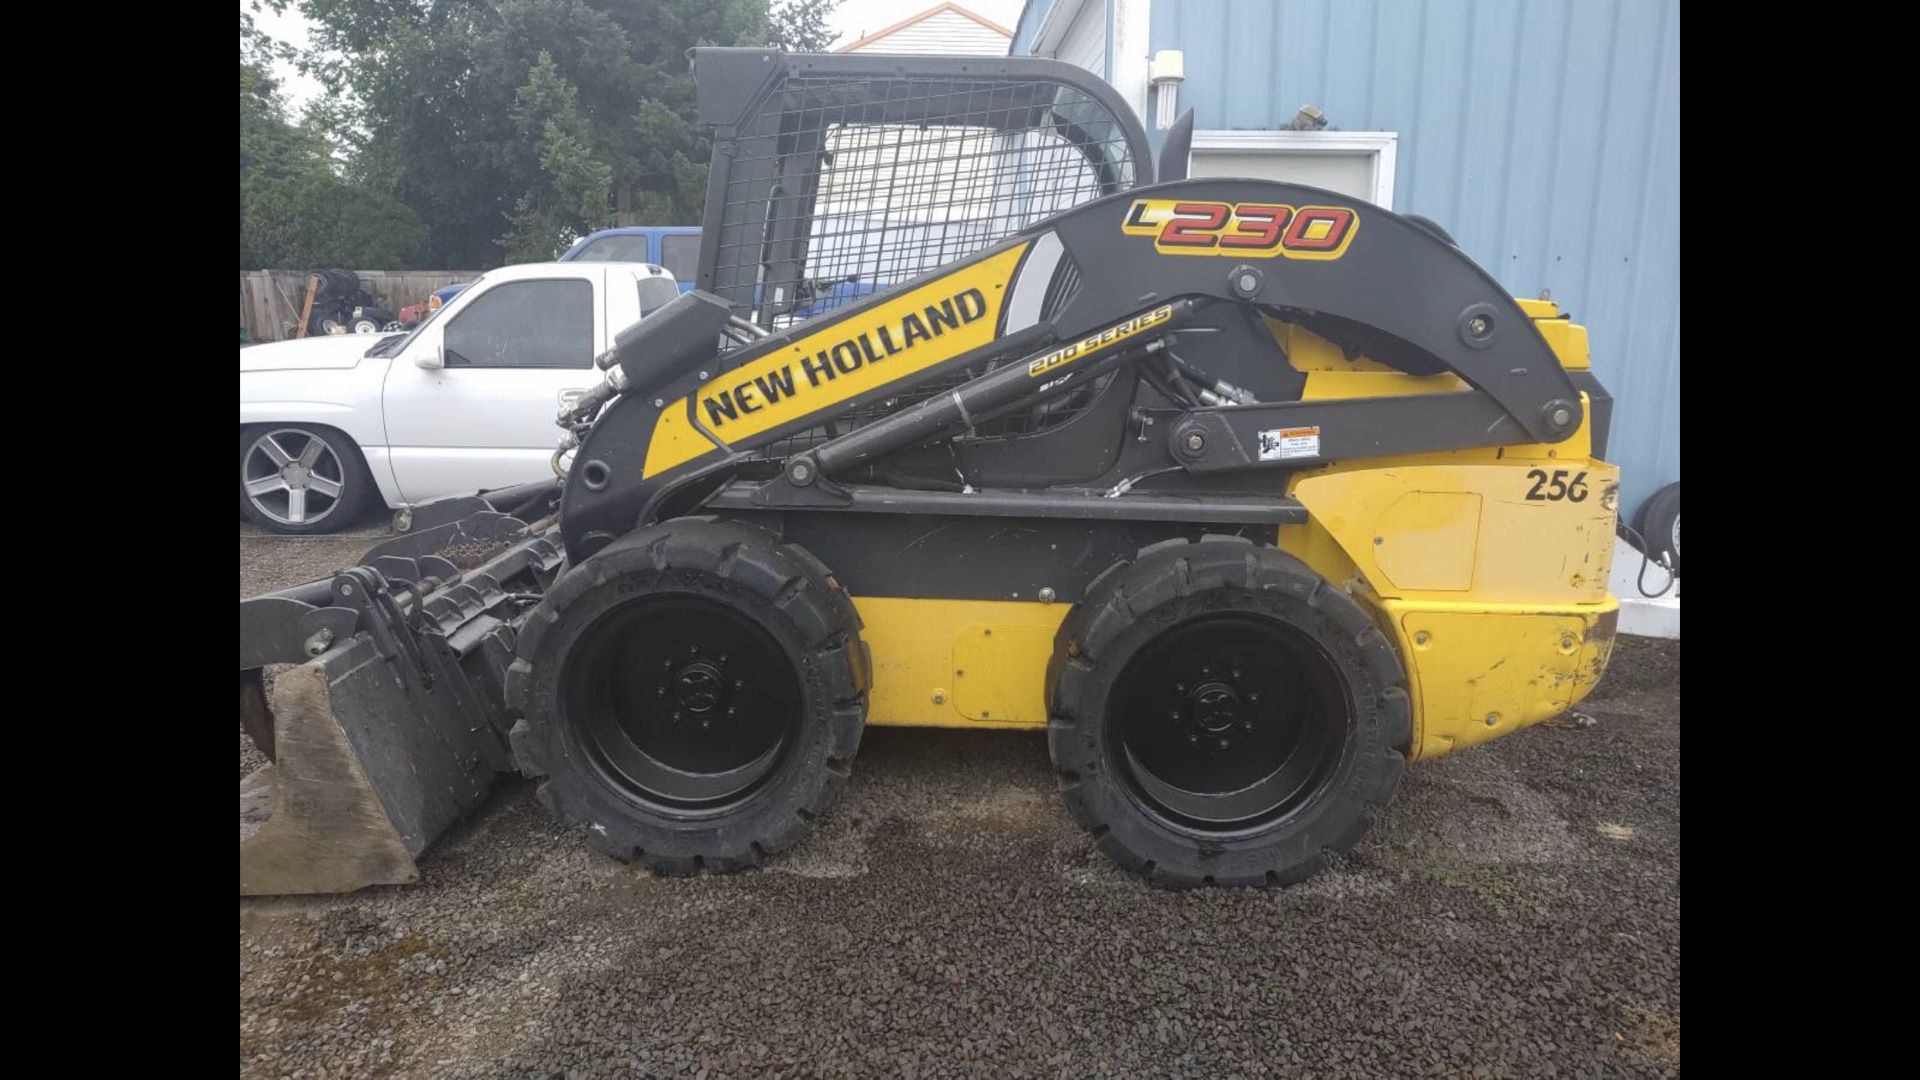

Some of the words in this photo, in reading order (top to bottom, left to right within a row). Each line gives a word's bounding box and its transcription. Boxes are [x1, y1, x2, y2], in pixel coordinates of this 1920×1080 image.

[1125, 201, 1356, 253] L230
[702, 365, 797, 427] NEW
[800, 287, 987, 388] HOLLAND
[1031, 345, 1078, 373] 200
[1084, 307, 1169, 348] SERIES
[1525, 469, 1589, 503] 256
